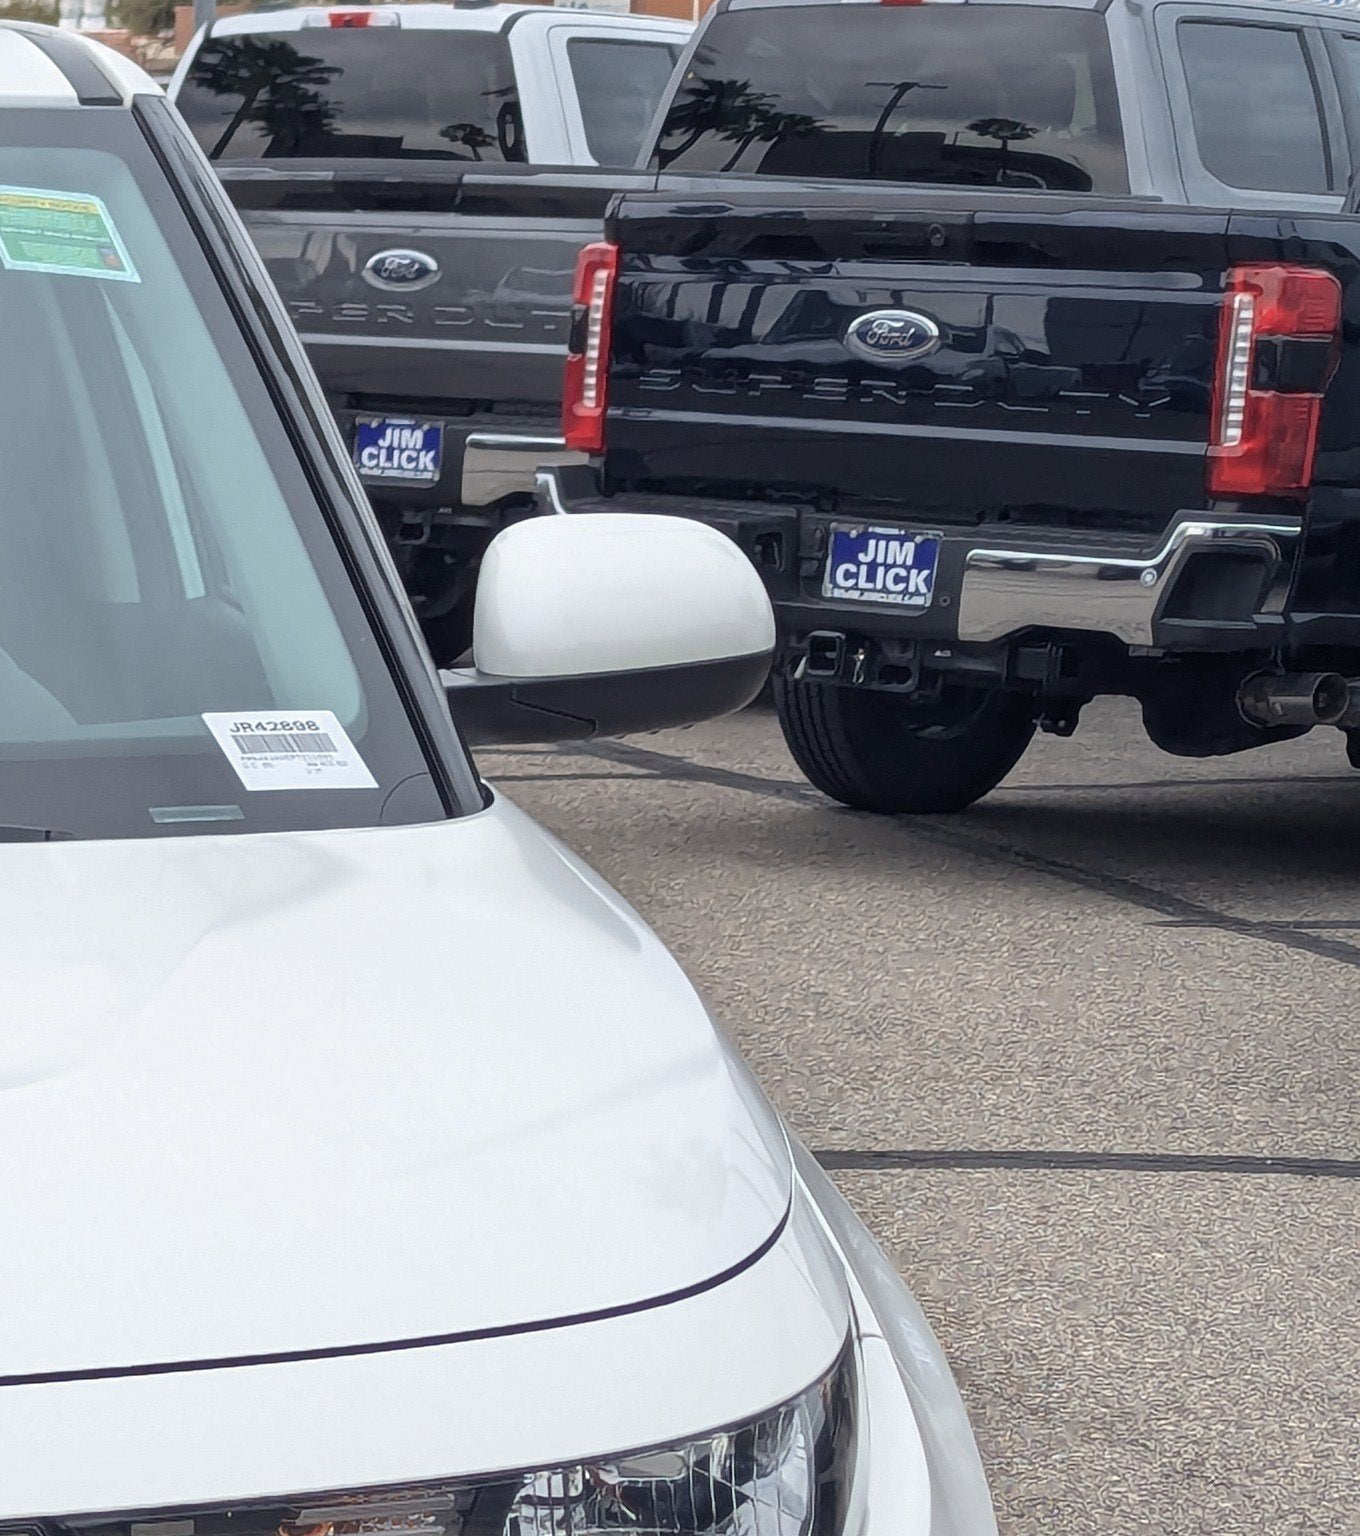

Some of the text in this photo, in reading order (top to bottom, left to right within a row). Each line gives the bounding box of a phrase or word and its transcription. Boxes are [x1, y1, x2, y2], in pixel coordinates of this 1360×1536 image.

[639, 368, 1172, 418] SUPER DUTY
[377, 427, 424, 449] JIM
[361, 446, 436, 471] CLICK
[858, 539, 915, 566] JIM
[835, 563, 931, 593] CLICK
